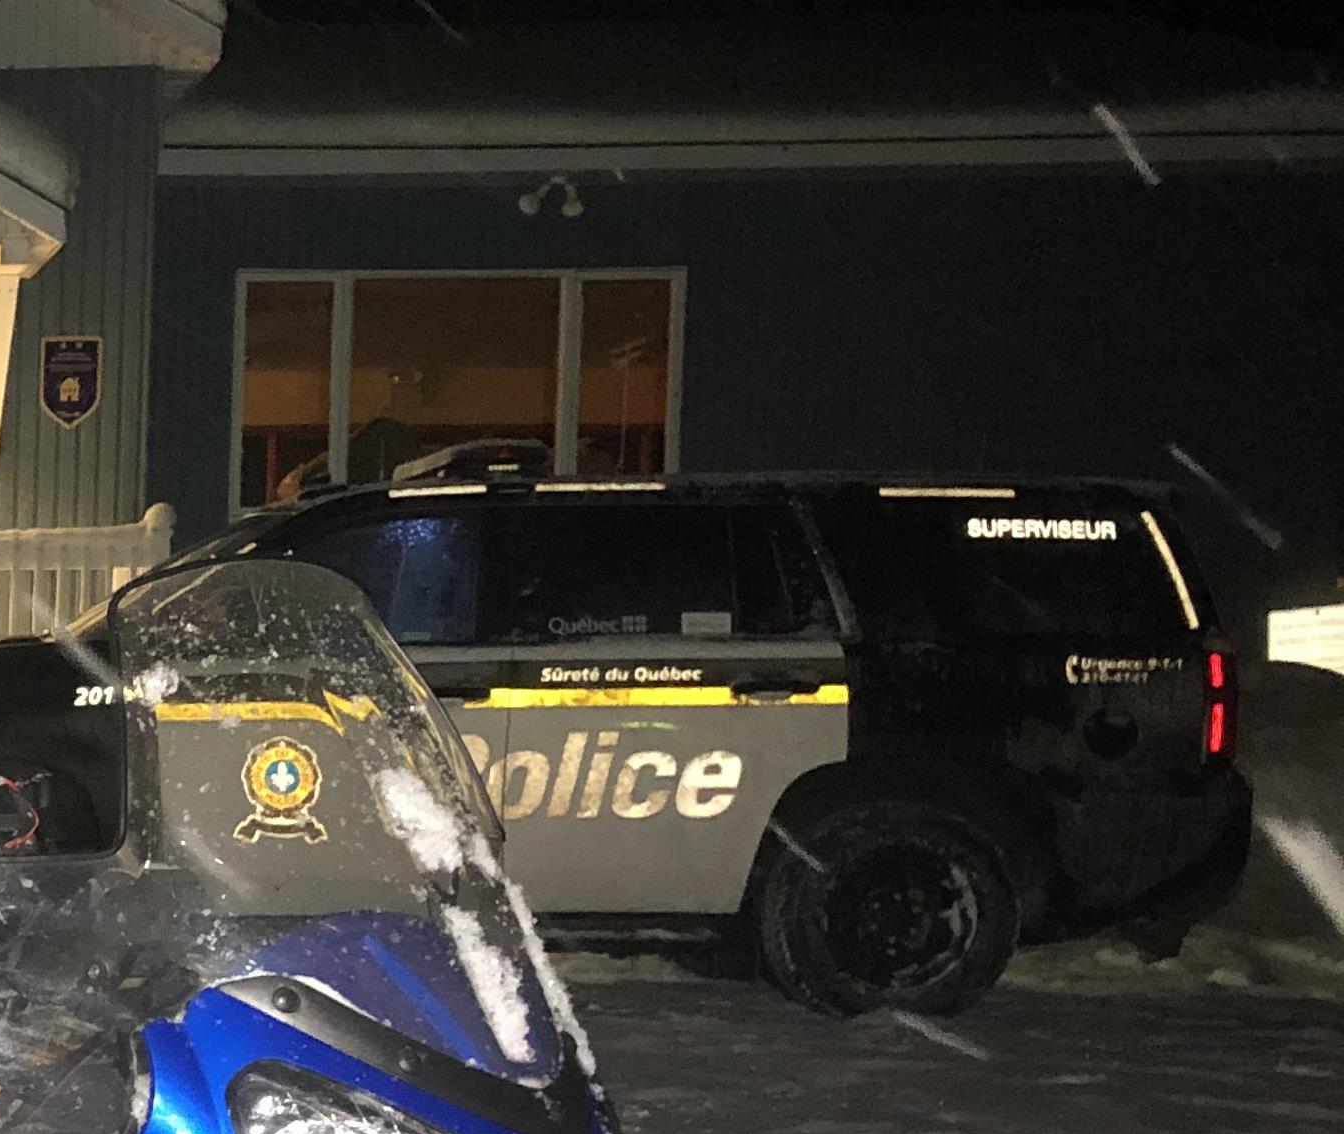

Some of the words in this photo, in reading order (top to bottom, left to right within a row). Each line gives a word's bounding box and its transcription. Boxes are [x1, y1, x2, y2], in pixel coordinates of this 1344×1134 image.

[967, 517, 1117, 541] SUPERVISEUR
[548, 615, 623, 636] Québec
[540, 667, 600, 683] Sûreté
[604, 667, 630, 682] du
[634, 666, 703, 683] Québec
